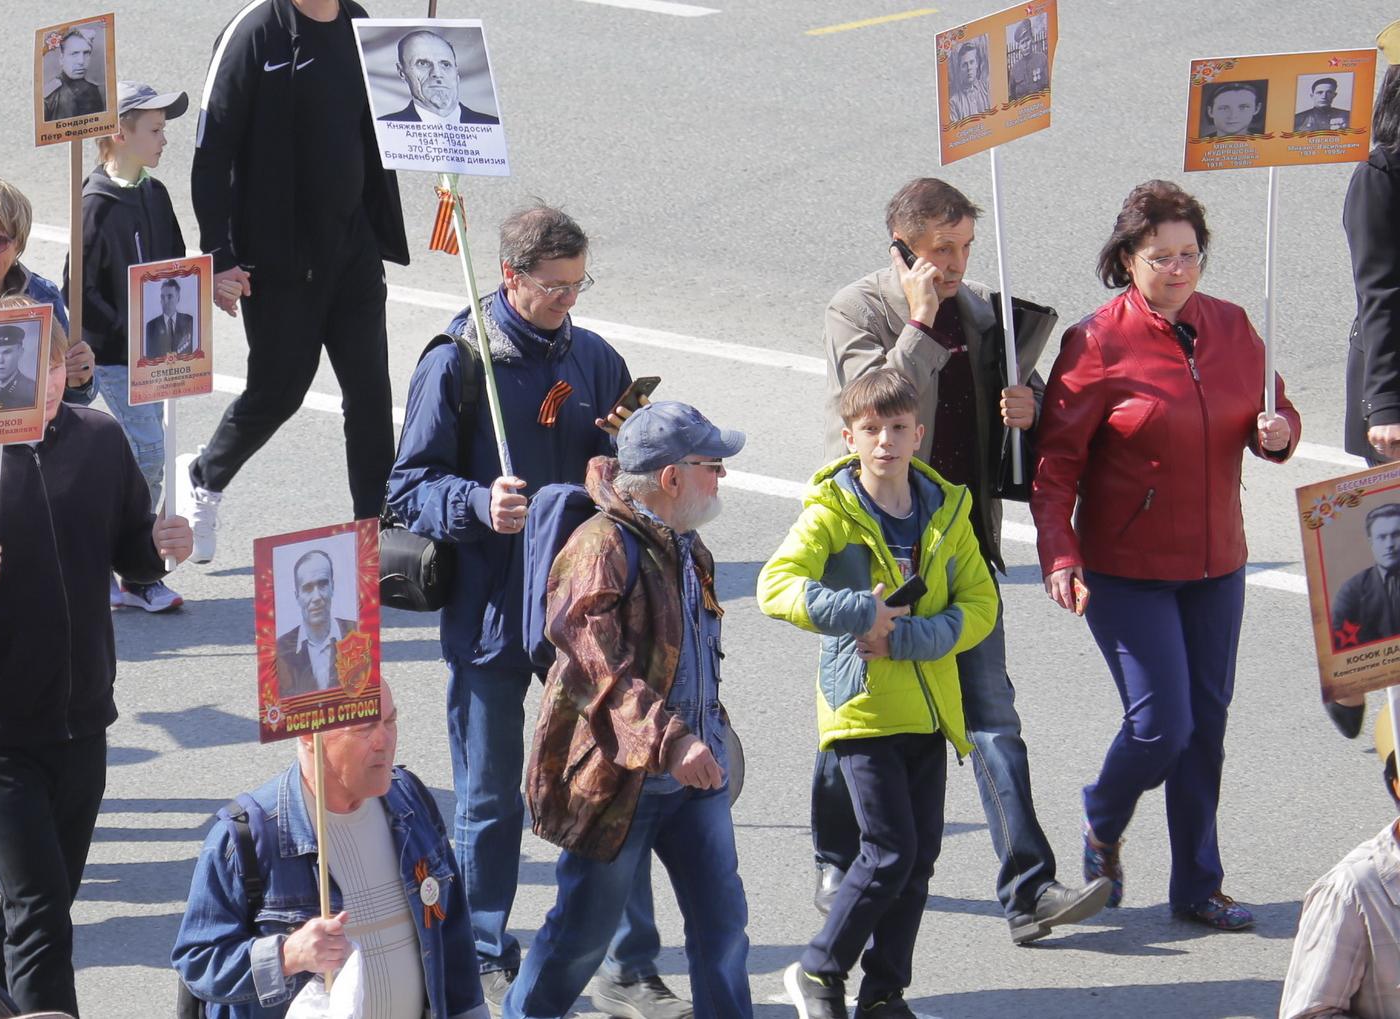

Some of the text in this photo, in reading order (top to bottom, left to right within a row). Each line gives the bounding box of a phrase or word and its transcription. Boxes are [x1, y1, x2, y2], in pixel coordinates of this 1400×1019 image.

[55, 116, 99, 129] Бондарев
[386, 122, 493, 133] Княжевский Феодосий
[405, 130, 478, 140] Александрович
[419, 138, 439, 146] 1941
[447, 139, 467, 147] 1944
[385, 150, 466, 163] Бранденбургская
[407, 145, 480, 156] 370 Стрелковая
[1346, 650, 1381, 665] КОСЮК
[286, 699, 378, 732] ВСЕГДА В СТРОЮ!
